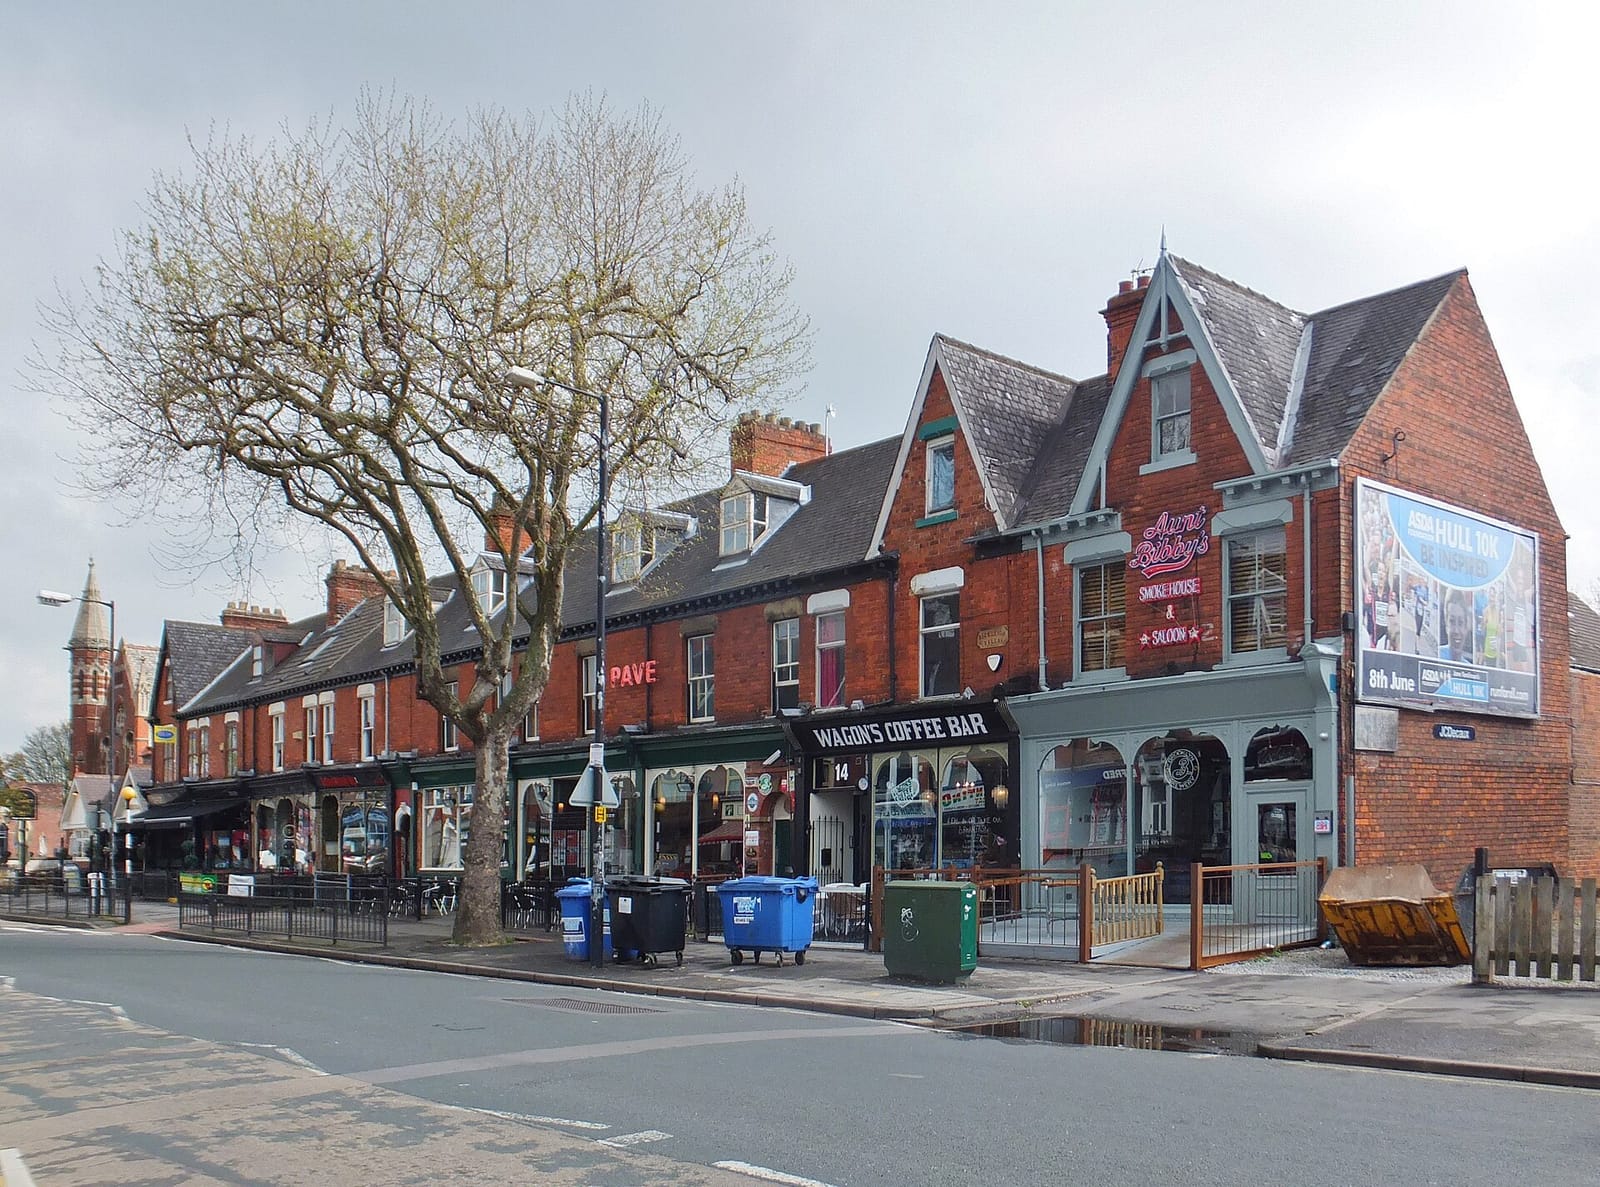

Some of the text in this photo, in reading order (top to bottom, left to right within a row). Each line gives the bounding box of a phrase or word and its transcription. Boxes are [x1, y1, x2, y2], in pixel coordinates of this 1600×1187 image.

[1144, 506, 1206, 540] Aunt
[1408, 510, 1434, 534] ASDA
[1436, 518, 1473, 553] HULL
[1476, 531, 1499, 560] 10K
[1129, 531, 1209, 579] Bibby's
[1421, 543, 1434, 566] BE
[1139, 577, 1200, 601] SMOKE HOUSE
[1166, 604, 1175, 619] &
[1151, 626, 1187, 645] SALOON
[610, 660, 656, 688] PAVE
[1369, 669, 1415, 691] 8th June
[1451, 682, 1471, 696] HULL
[812, 712, 988, 748] WAGON'S COFFEE BAR
[834, 763, 849, 781] 14
